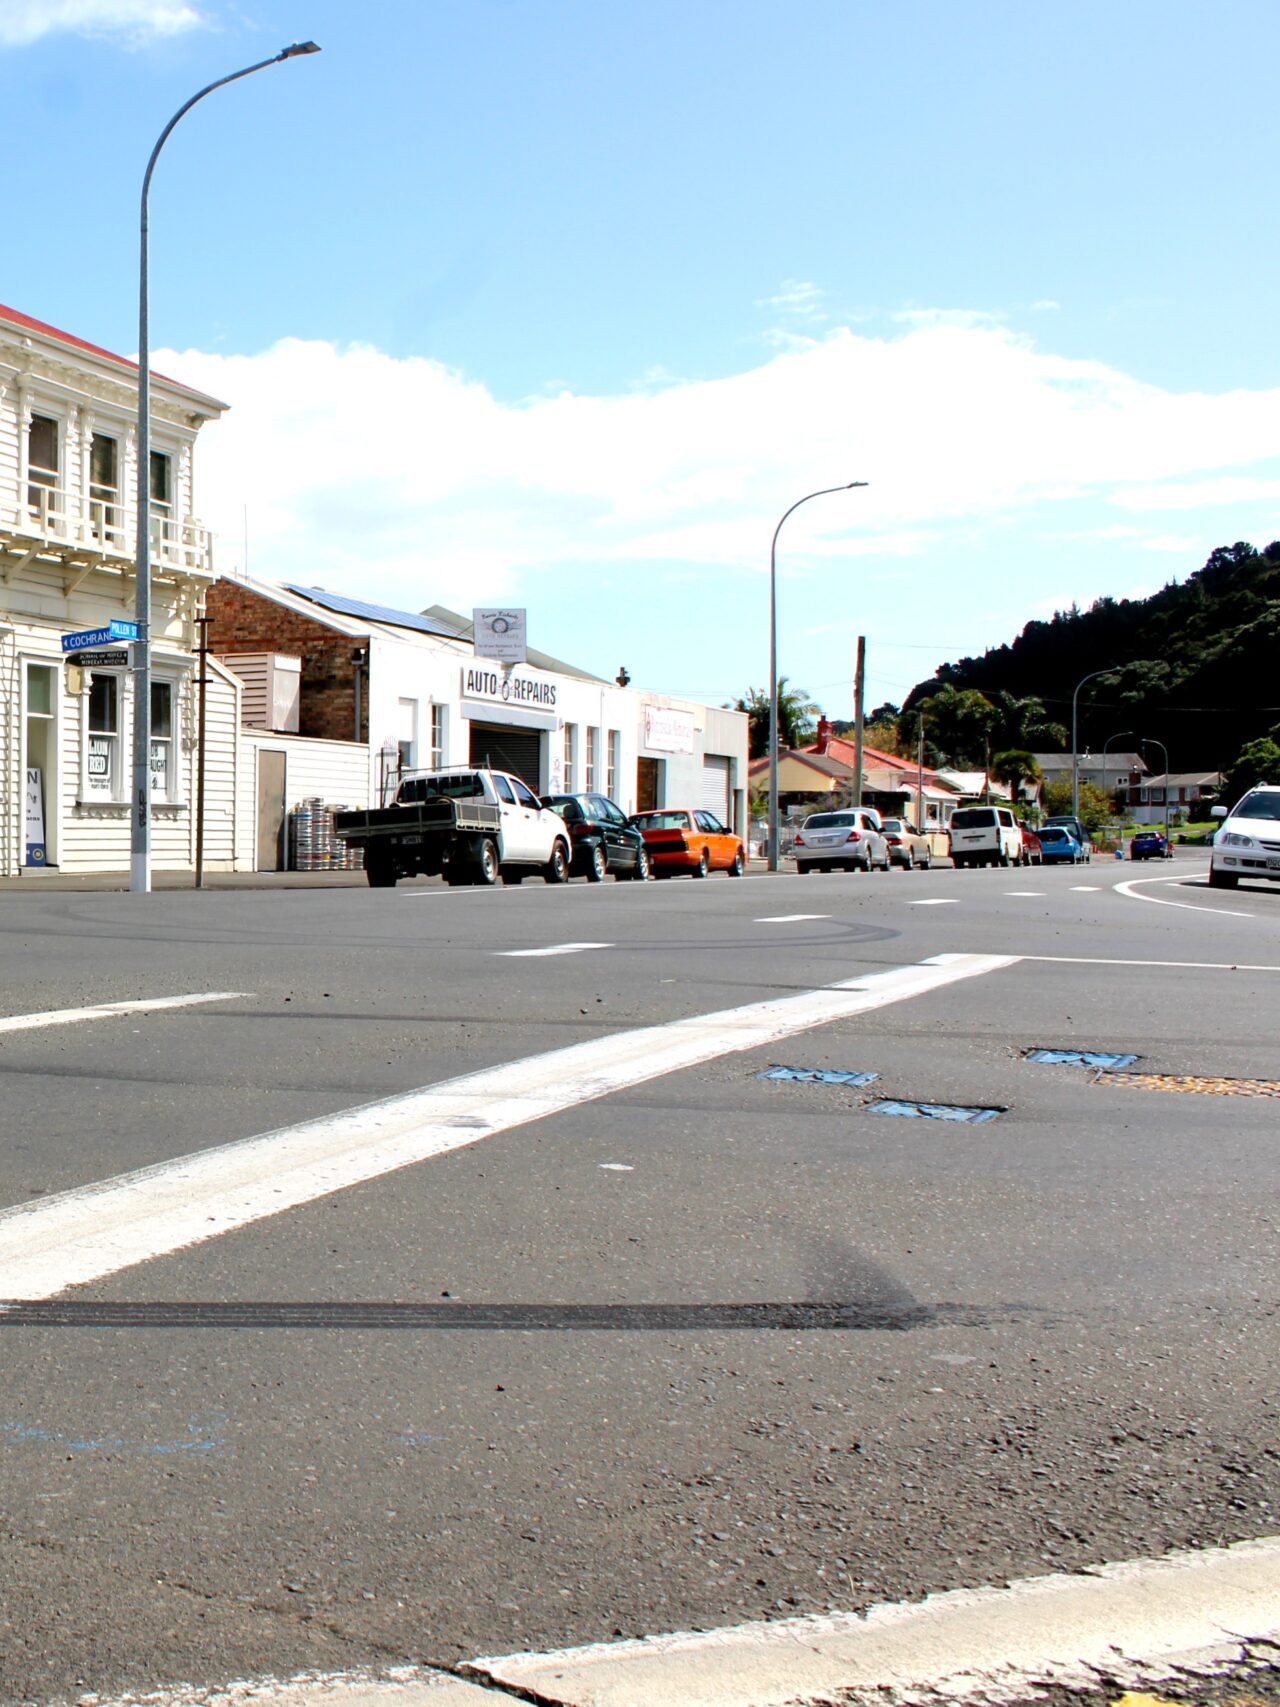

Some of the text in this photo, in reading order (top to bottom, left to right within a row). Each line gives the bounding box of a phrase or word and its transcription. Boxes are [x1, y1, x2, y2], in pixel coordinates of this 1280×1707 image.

[111, 622, 138, 637] POLLEN ST
[467, 669, 557, 706] AUTO REPAIRS
[89, 756, 106, 773] RED
